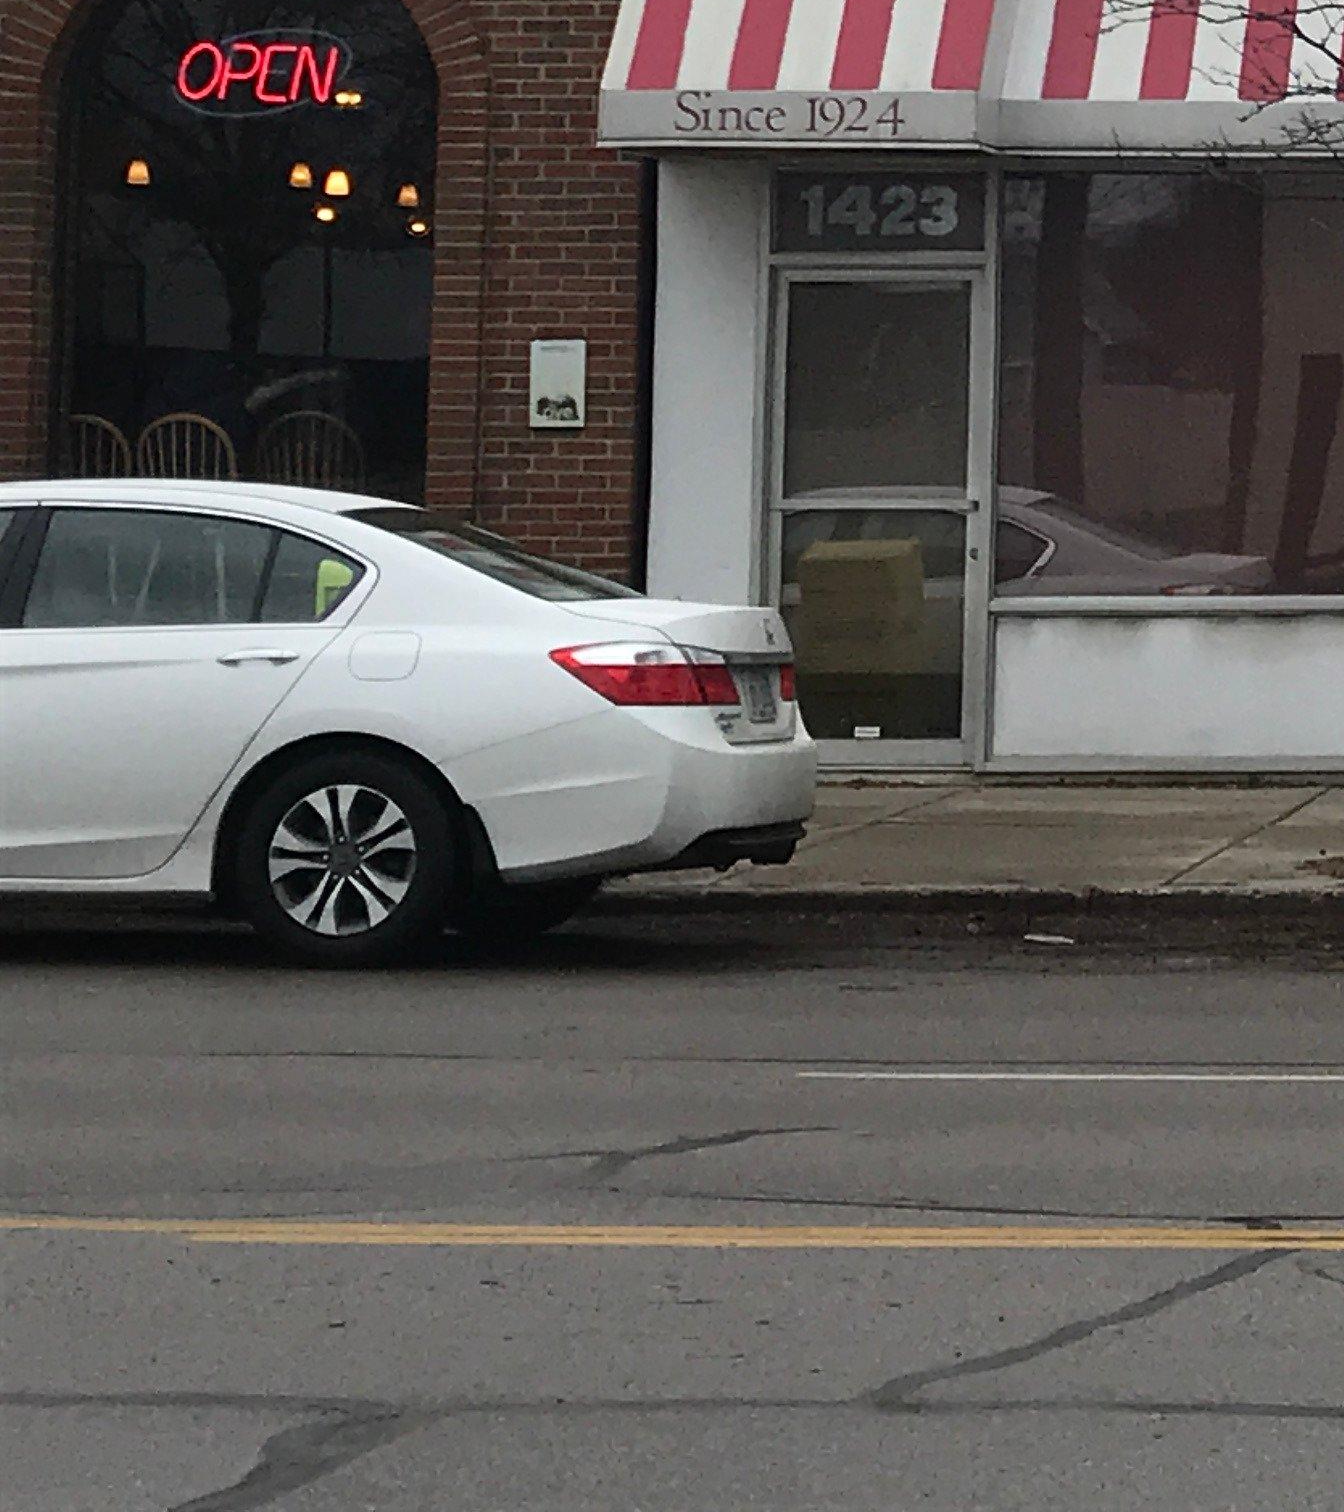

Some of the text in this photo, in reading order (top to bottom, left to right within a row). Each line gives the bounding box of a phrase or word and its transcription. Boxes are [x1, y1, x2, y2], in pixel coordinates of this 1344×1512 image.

[177, 41, 339, 105] OPEN
[672, 90, 905, 137] Since 1924
[799, 185, 959, 236] 1423
